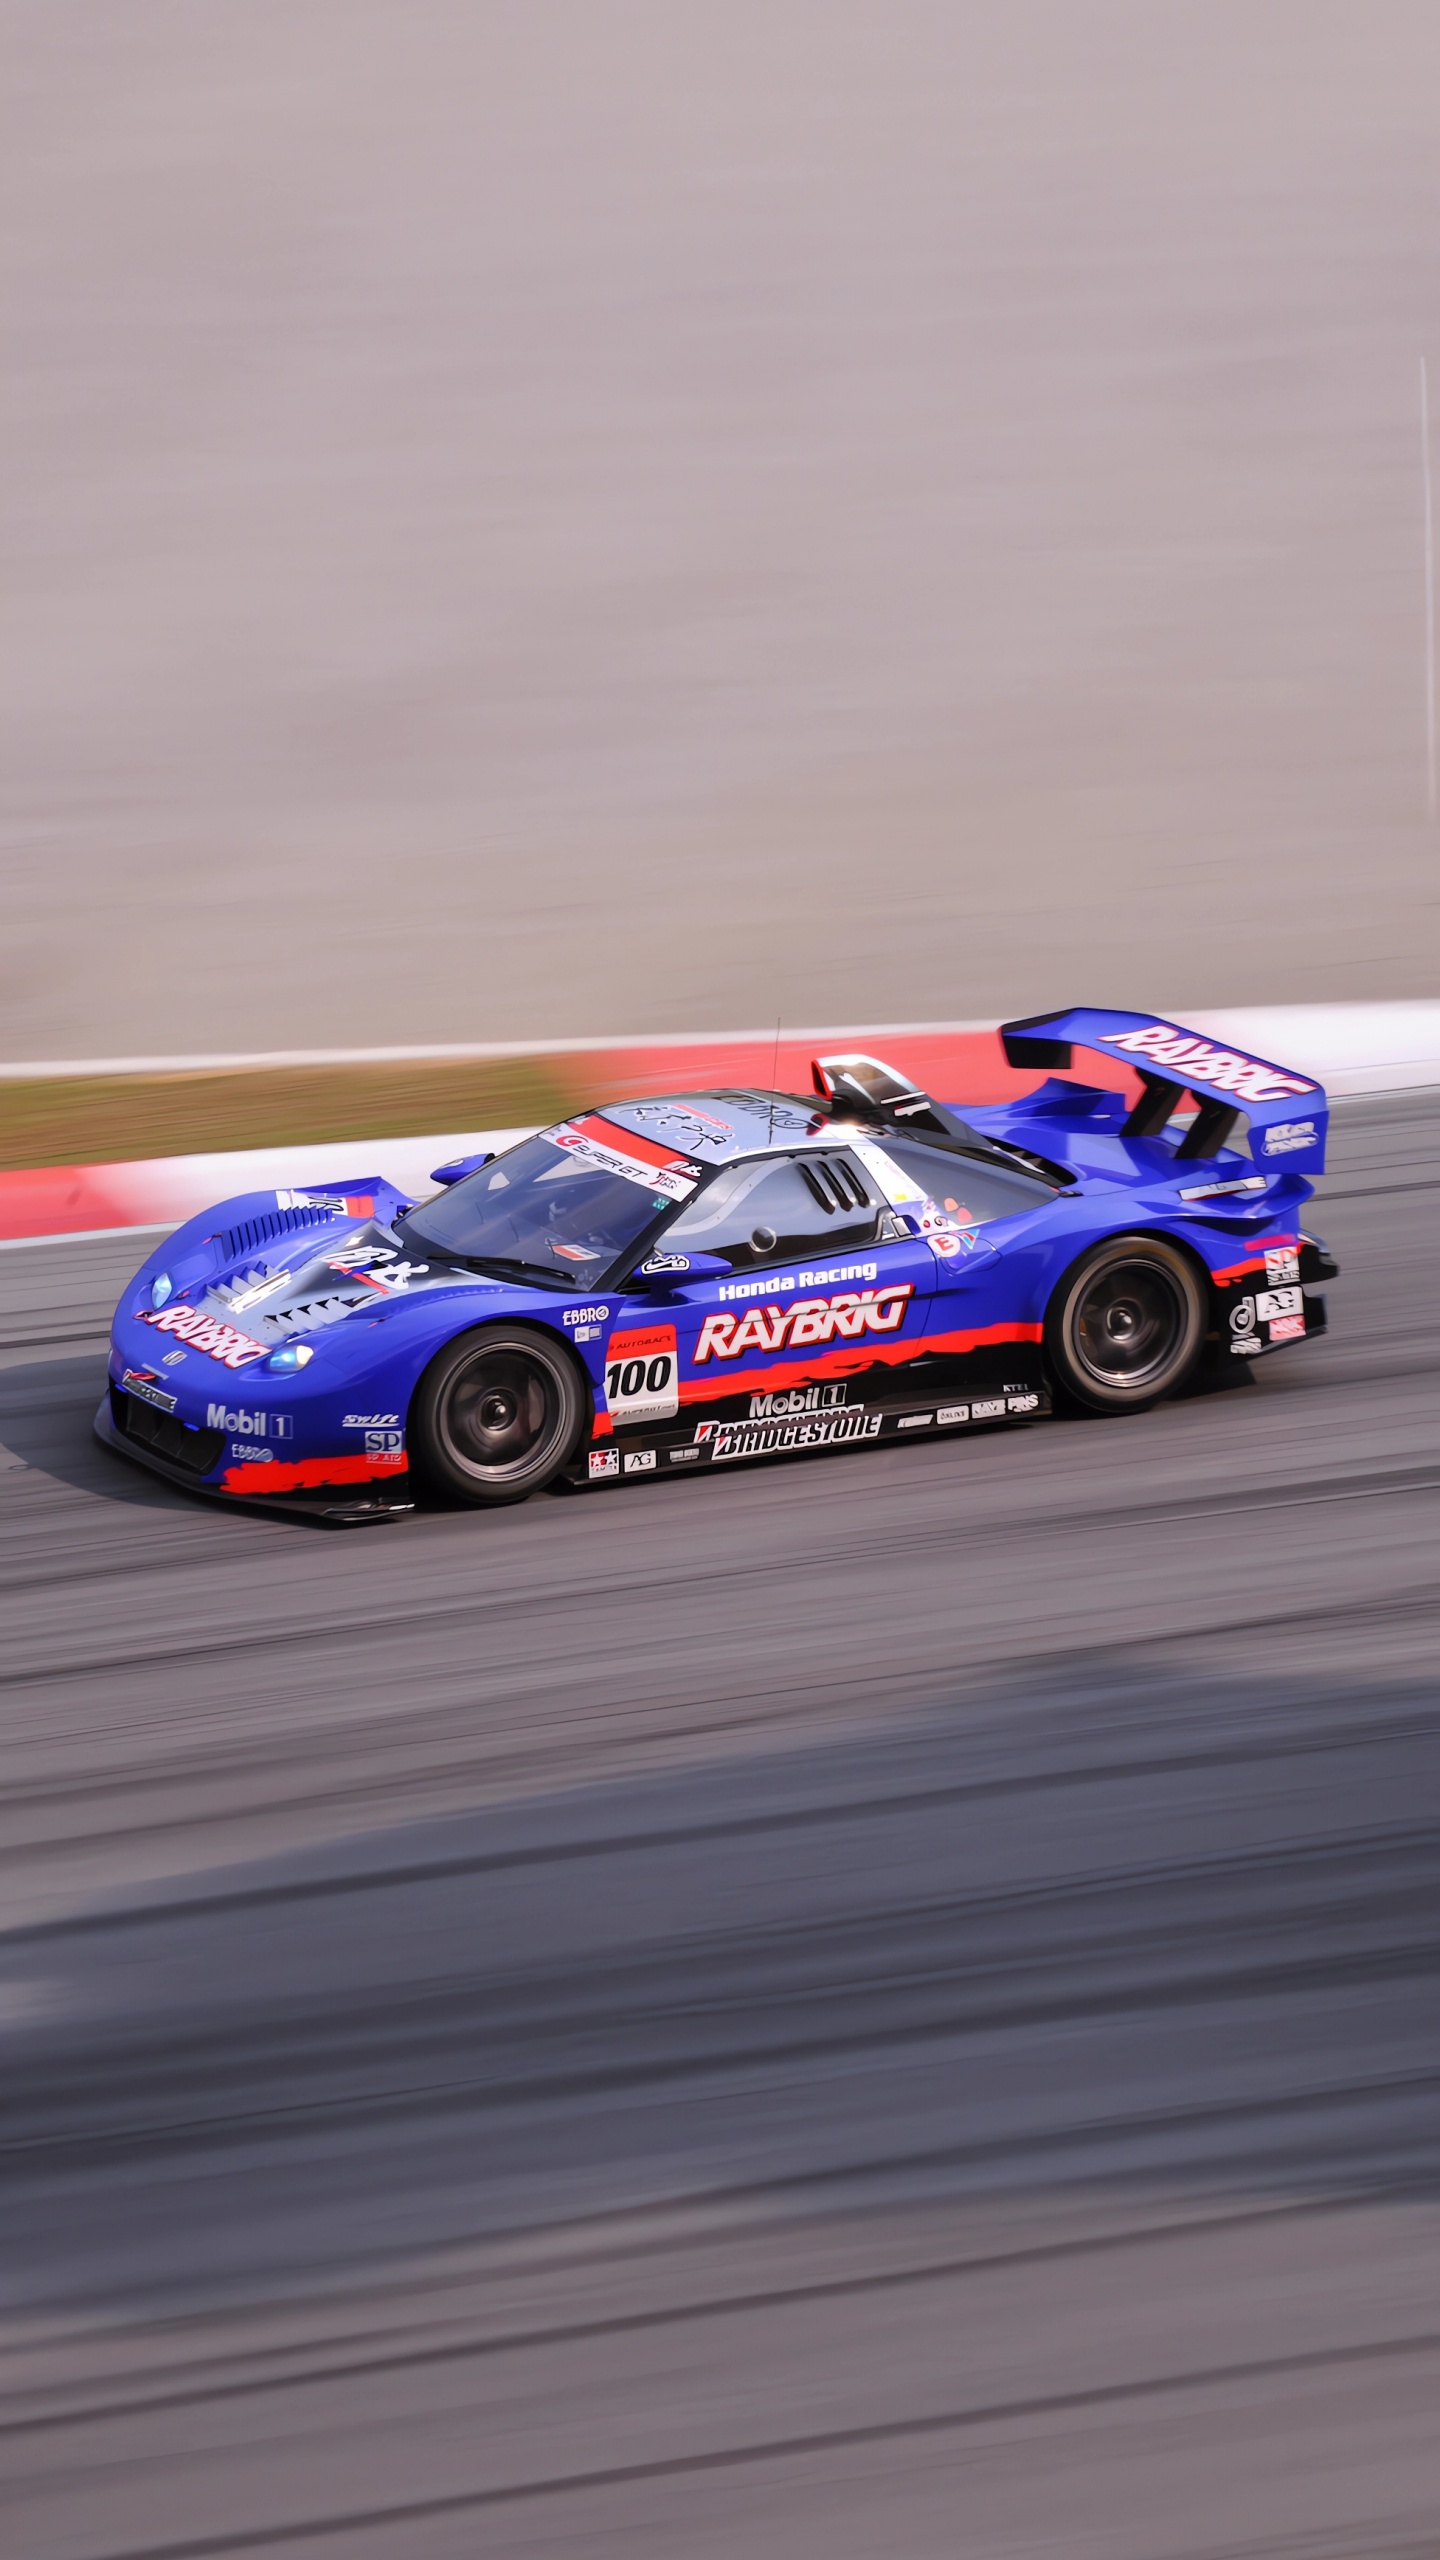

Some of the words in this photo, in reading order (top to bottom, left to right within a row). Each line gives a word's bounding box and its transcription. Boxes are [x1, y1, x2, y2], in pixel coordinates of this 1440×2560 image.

[1095, 1024, 1319, 1103] RAYBRIG
[718, 1276, 796, 1302] Honda
[798, 1262, 878, 1289] Racing
[562, 1305, 610, 1327] EBBRO
[692, 1282, 916, 1365] RAYBRIG
[607, 1355, 672, 1400] 100
[206, 1403, 267, 1437] Mobil
[749, 1387, 820, 1419] Mobil
[366, 1432, 401, 1452] SP
